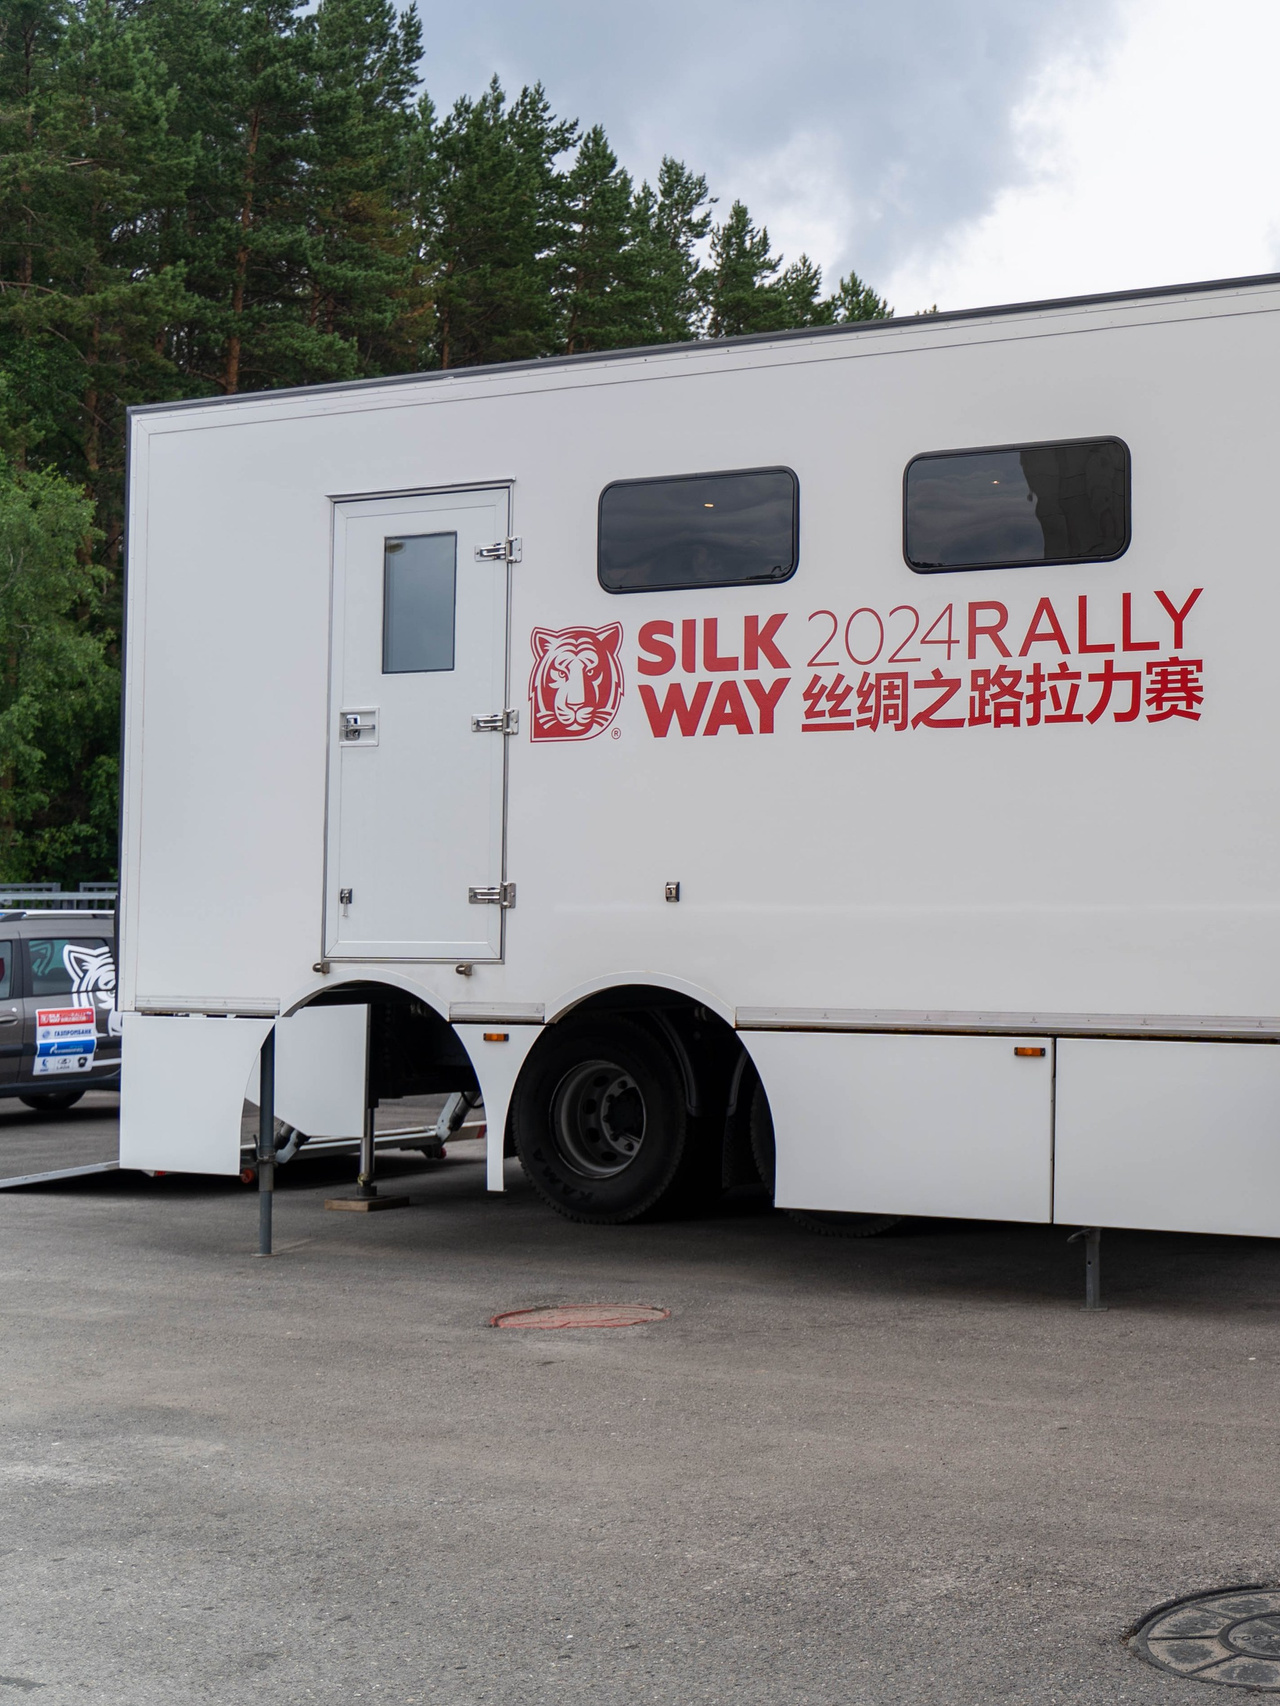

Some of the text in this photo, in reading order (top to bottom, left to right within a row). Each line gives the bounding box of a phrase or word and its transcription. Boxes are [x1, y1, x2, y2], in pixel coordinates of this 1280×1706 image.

[637, 613, 790, 675] SILK
[638, 656, 1204, 738] WAY 丝绸之路拉力赛
